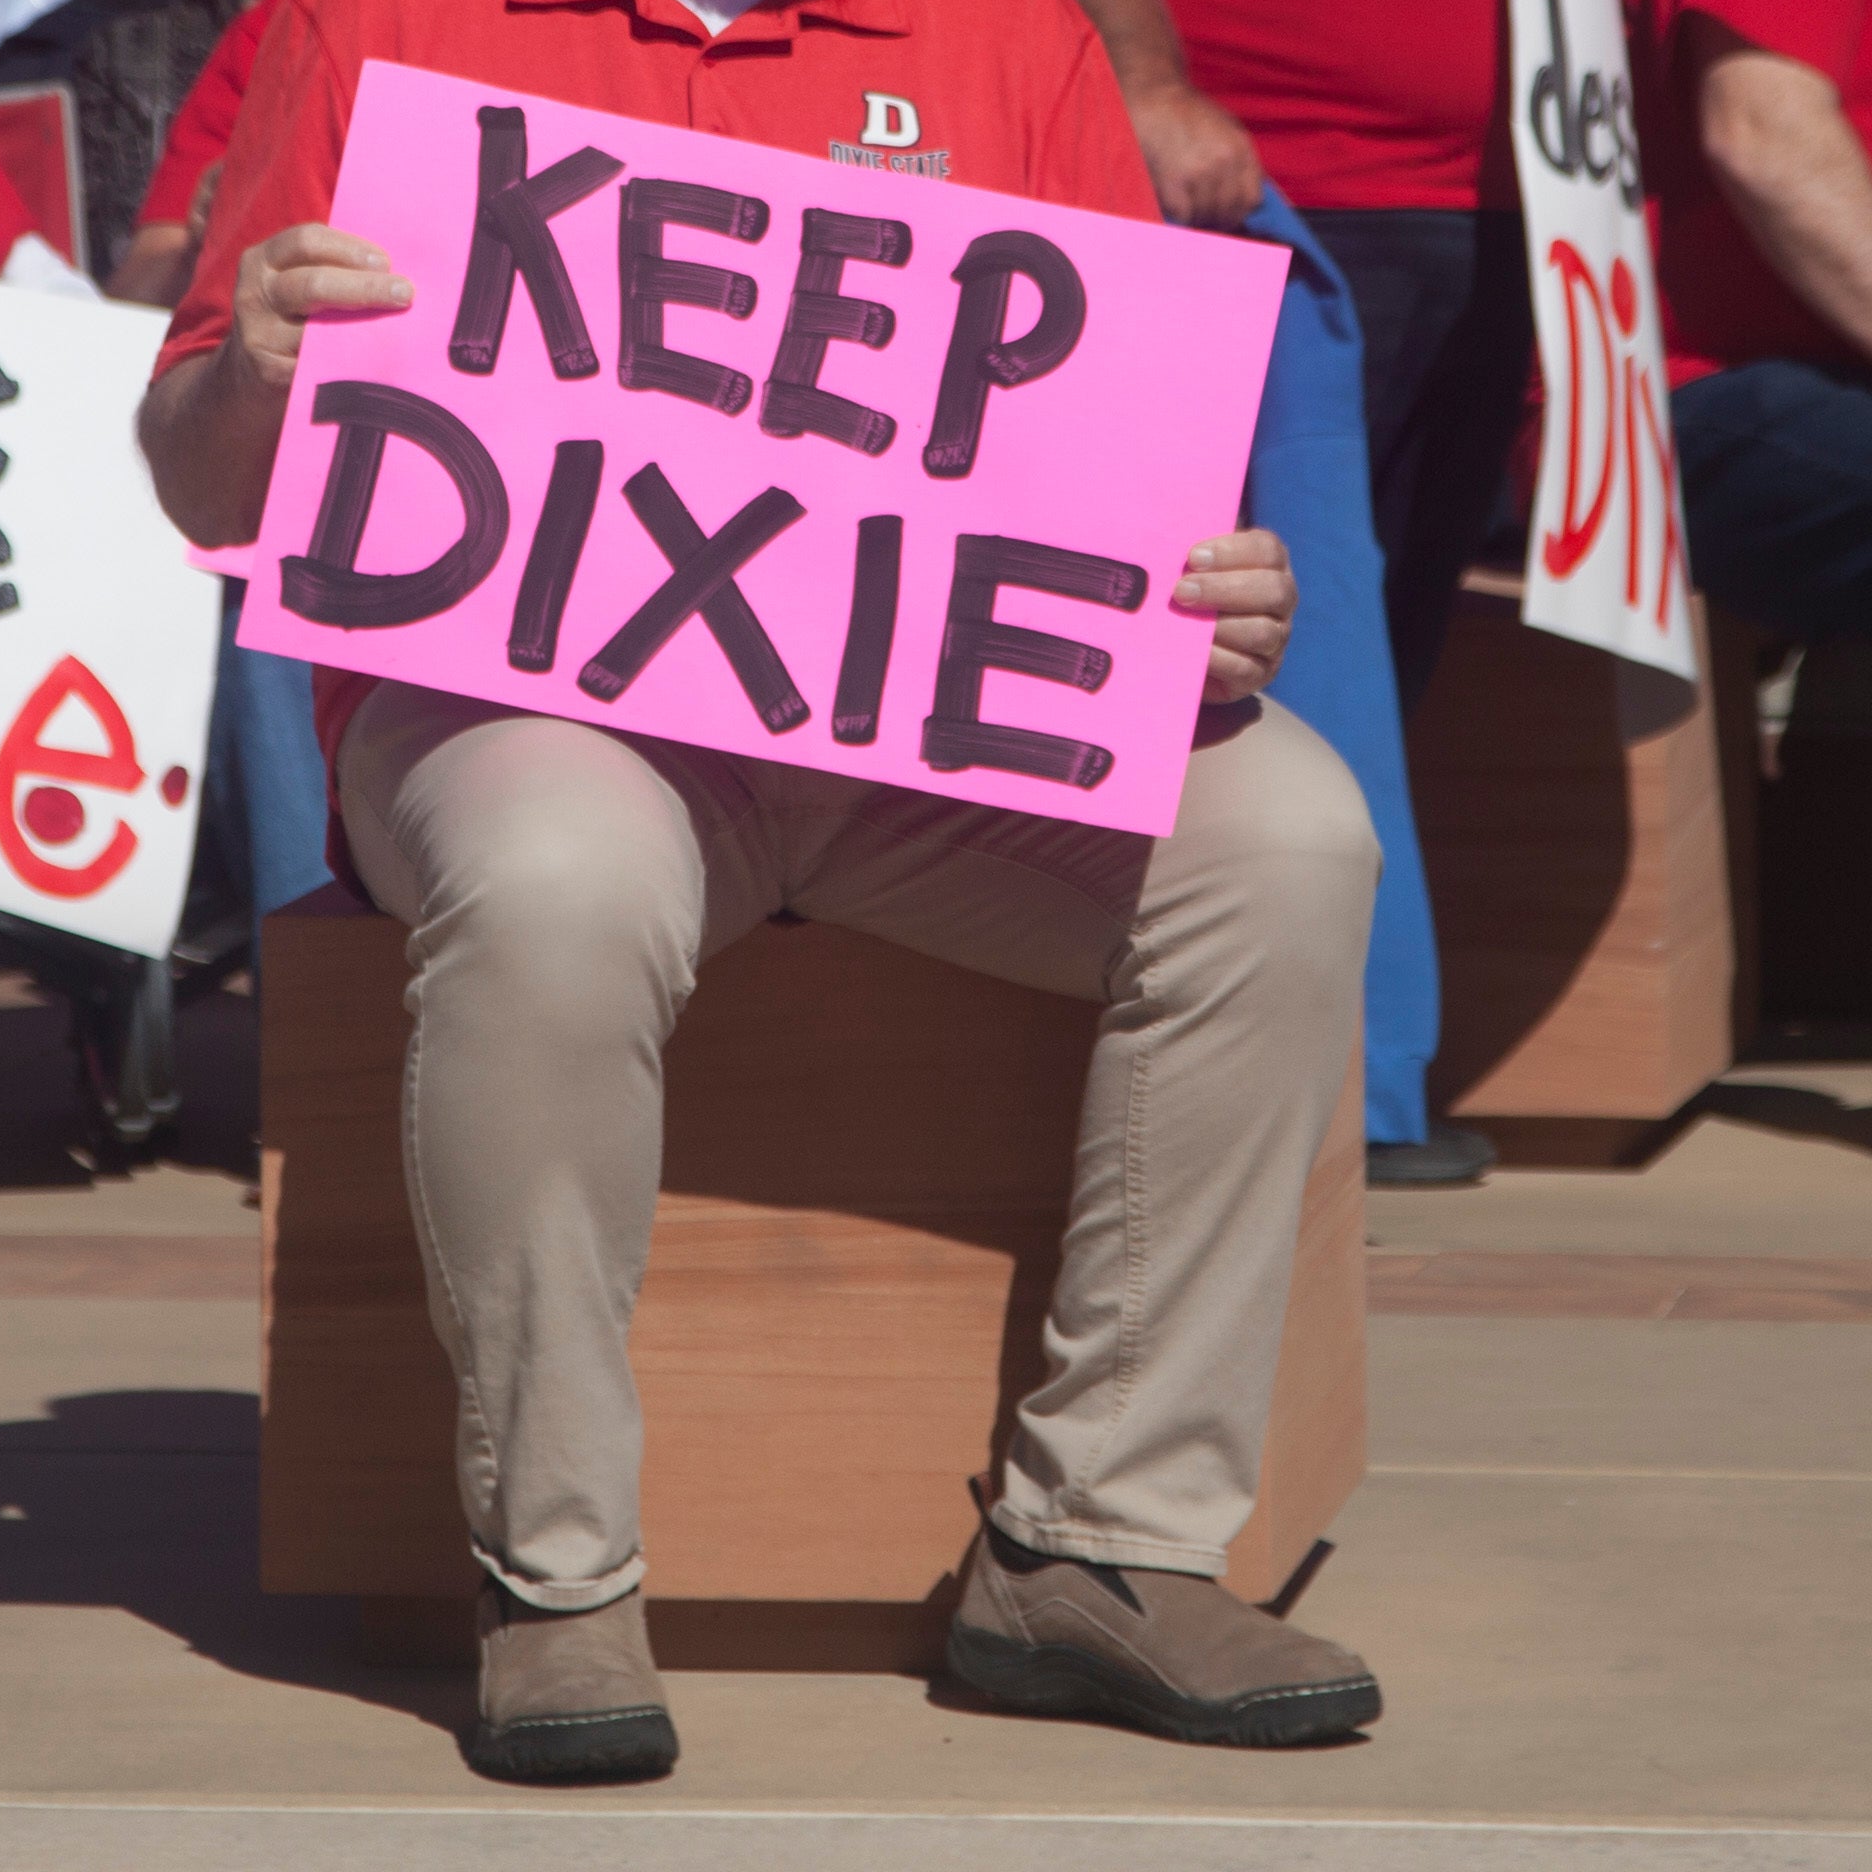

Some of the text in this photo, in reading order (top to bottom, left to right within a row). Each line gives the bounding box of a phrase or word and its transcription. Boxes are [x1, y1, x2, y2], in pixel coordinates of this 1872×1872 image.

[830, 141, 951, 182] DIXIE STATE
[859, 91, 922, 148] D
[449, 105, 1088, 478] KEEP
[279, 379, 1149, 790] DIXIE
